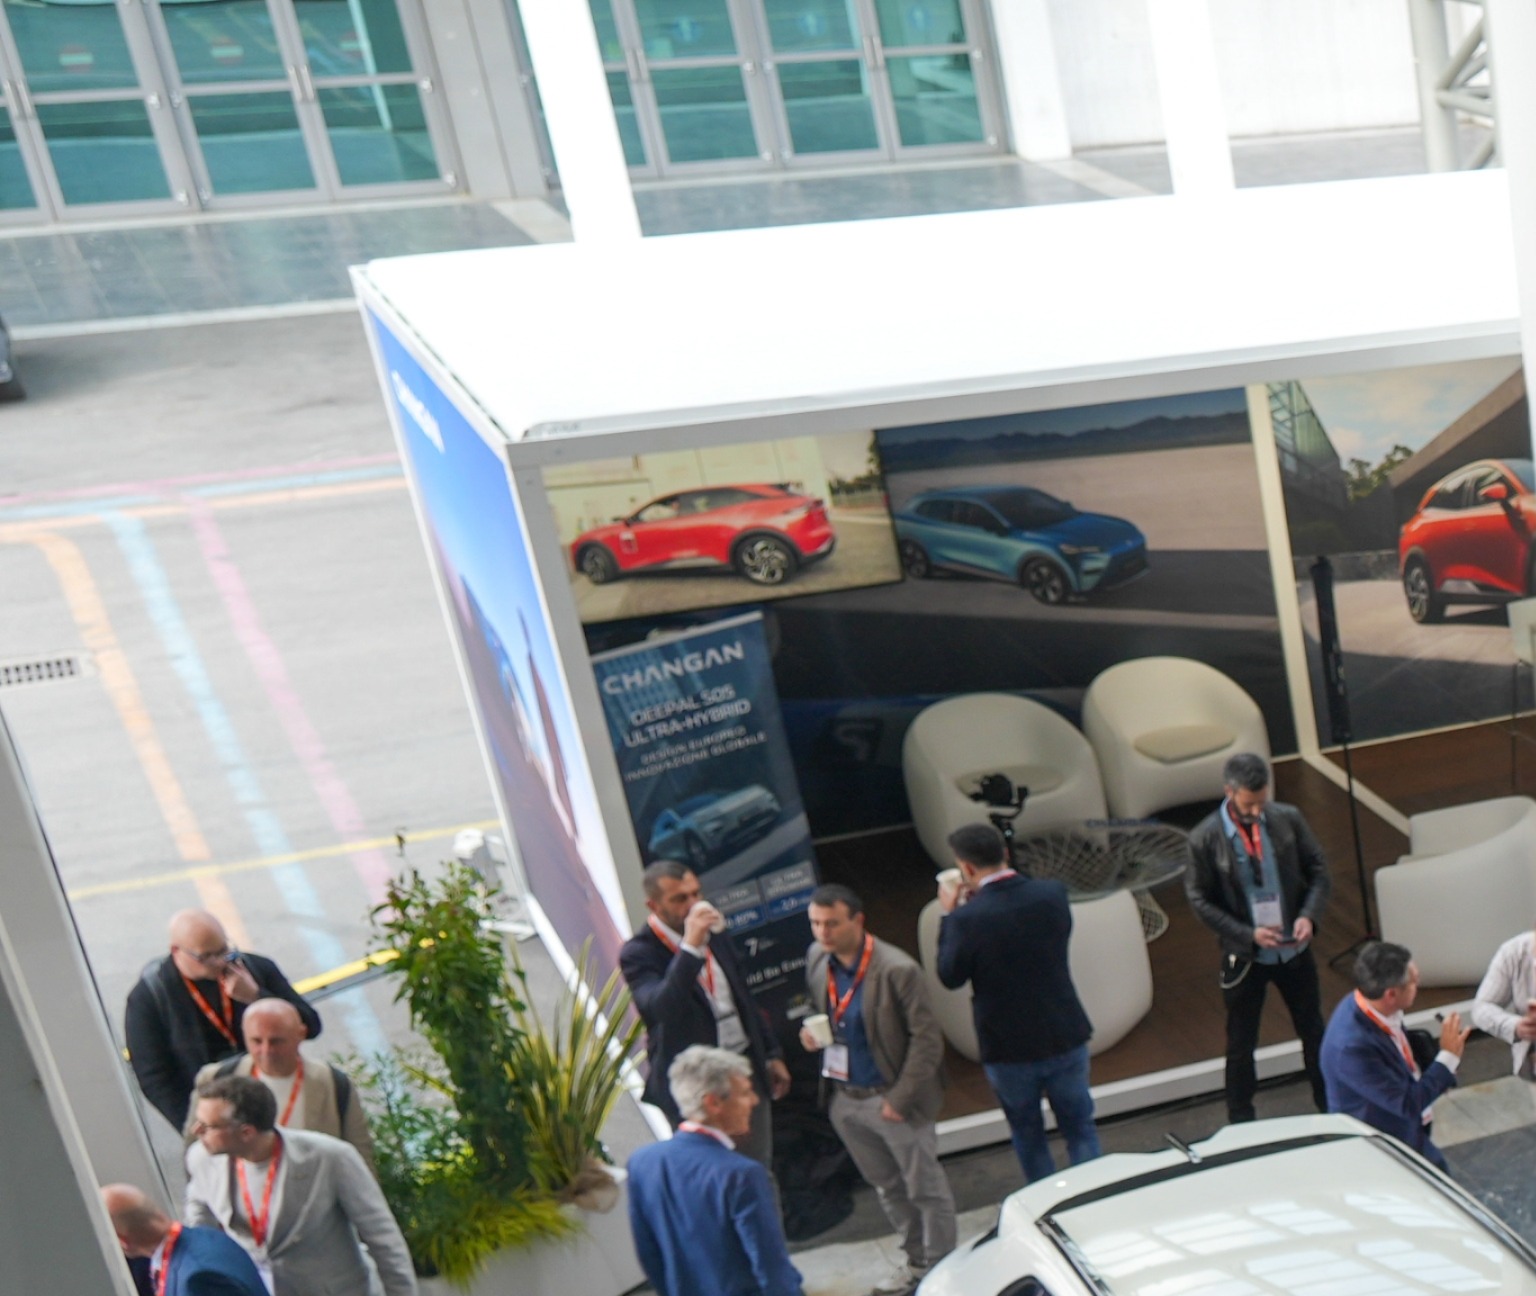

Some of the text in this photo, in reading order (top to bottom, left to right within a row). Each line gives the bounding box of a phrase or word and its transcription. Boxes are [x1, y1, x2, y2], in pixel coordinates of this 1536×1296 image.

[602, 641, 744, 695] CHANGAN
[623, 698, 752, 747] ULTRA-HYBRID
[630, 683, 736, 726] DEEPAL S05
